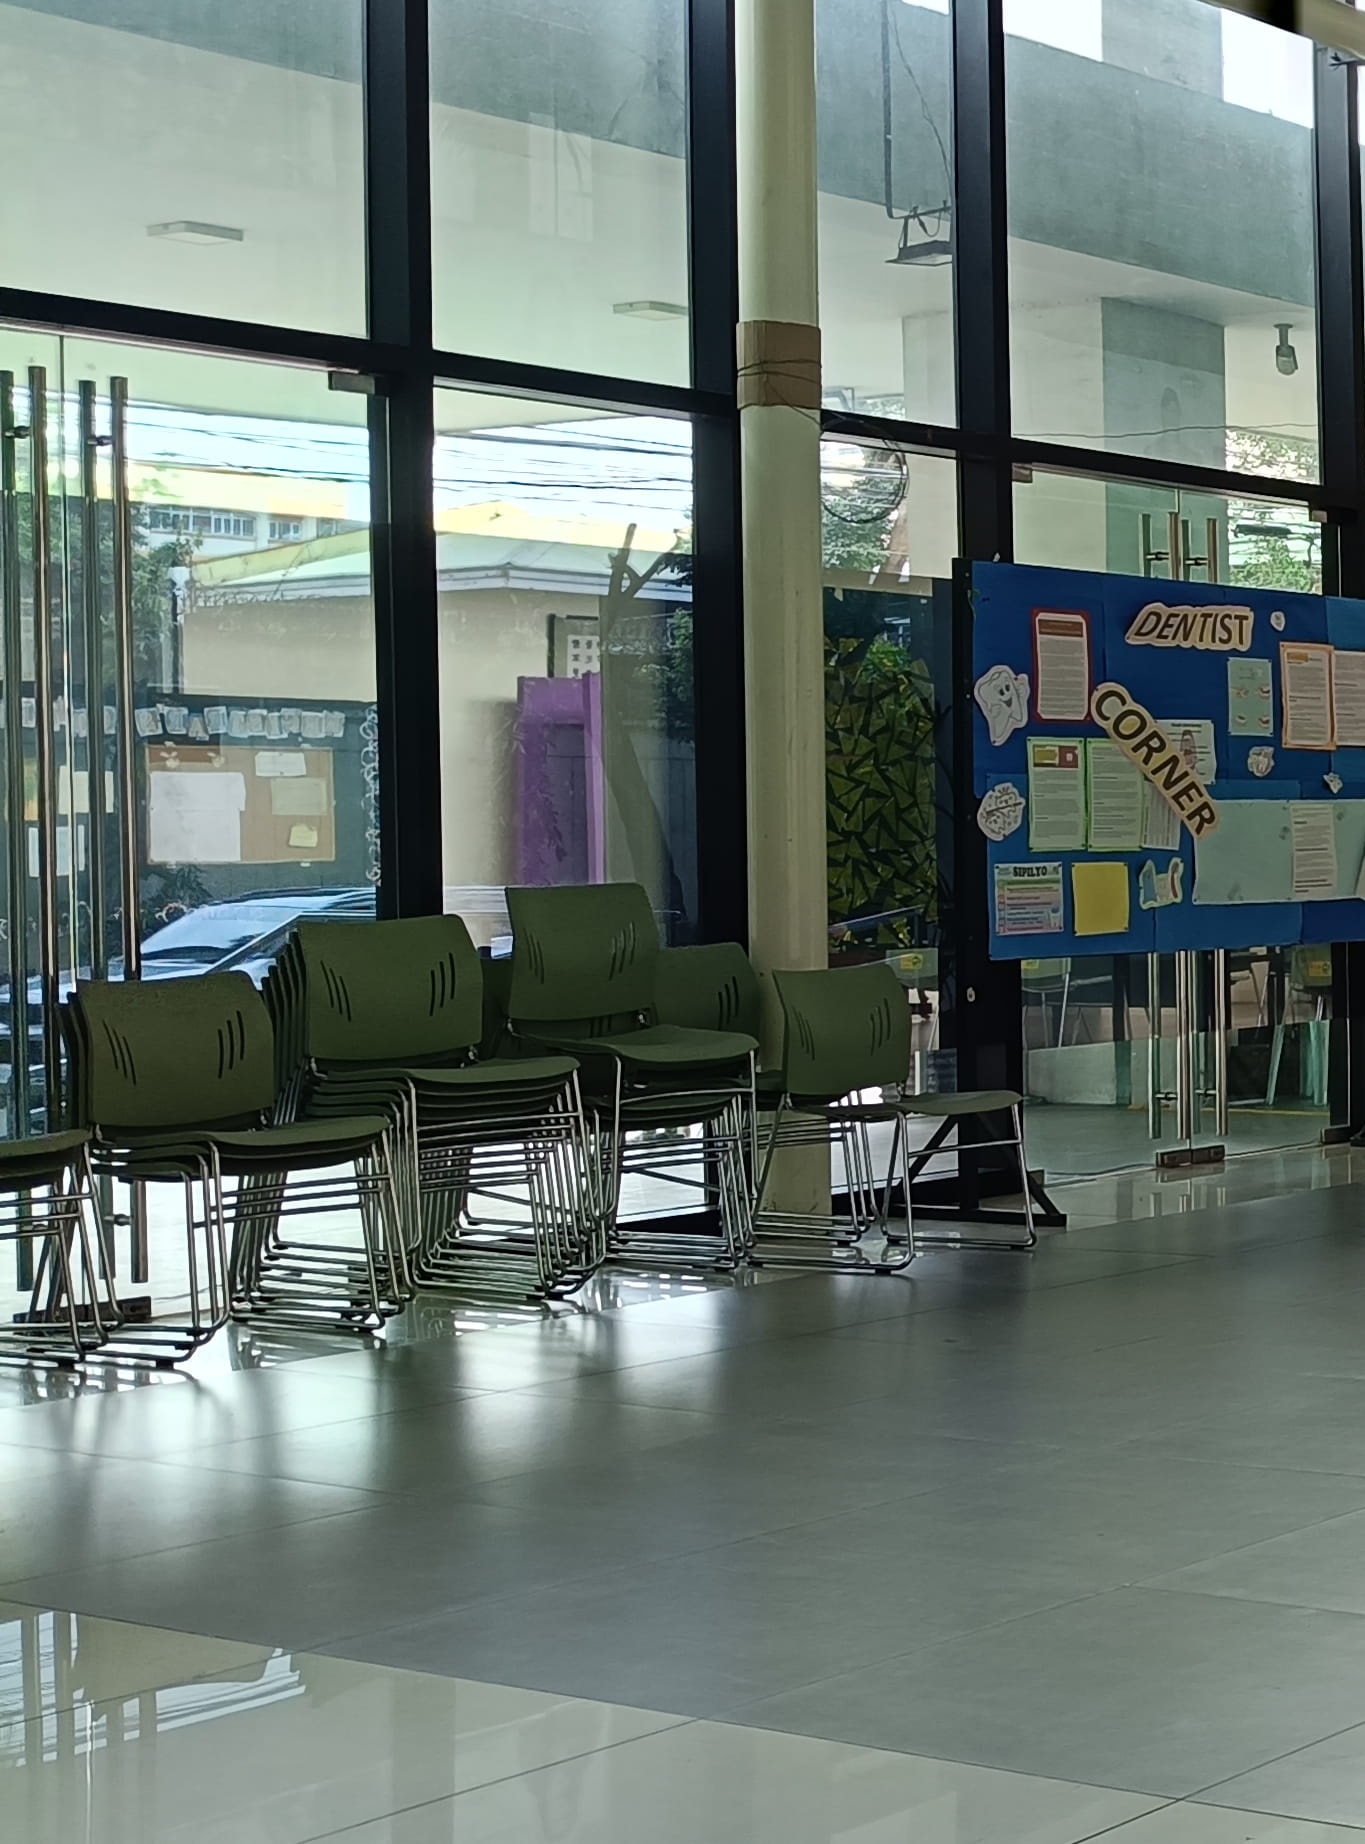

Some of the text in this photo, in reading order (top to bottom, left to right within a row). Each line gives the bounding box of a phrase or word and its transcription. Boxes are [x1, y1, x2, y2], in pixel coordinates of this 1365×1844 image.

[1134, 610, 1251, 647] DENTIST
[1094, 688, 1218, 836] CORNER
[1012, 865, 1048, 878] SIPILYO
